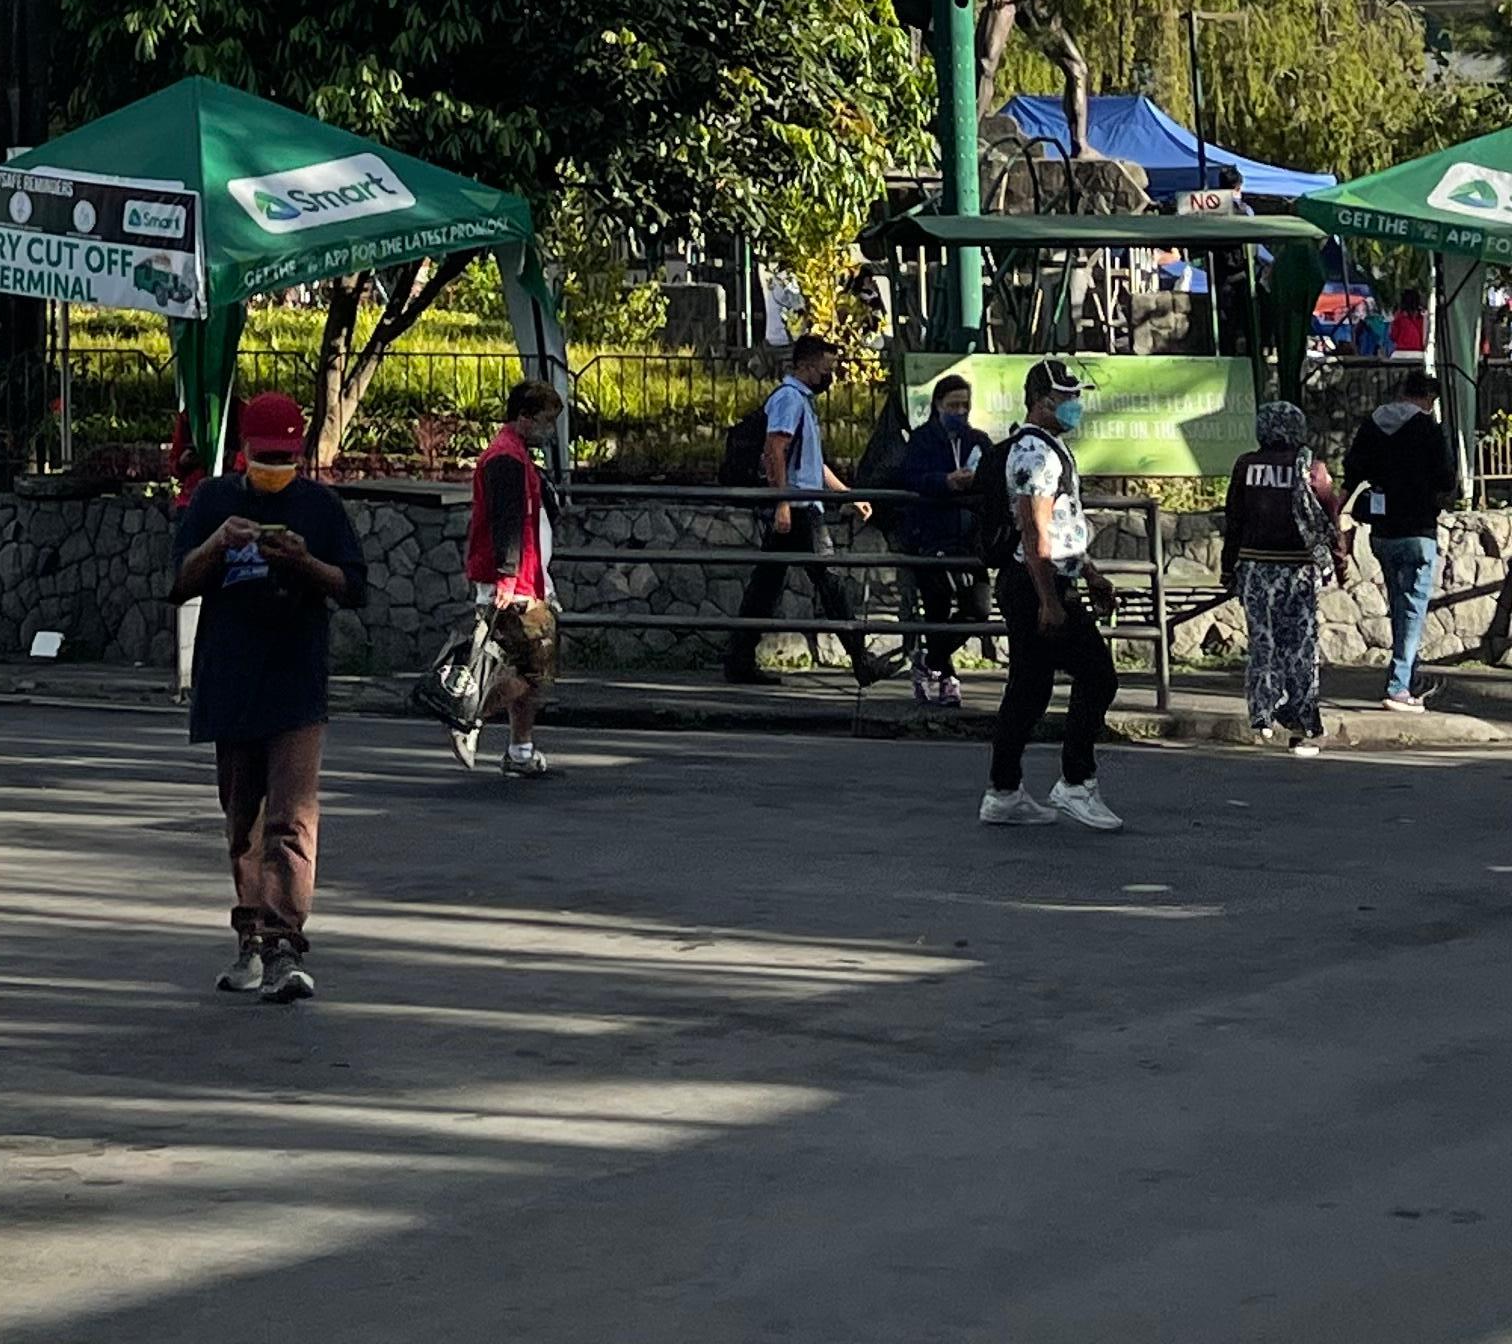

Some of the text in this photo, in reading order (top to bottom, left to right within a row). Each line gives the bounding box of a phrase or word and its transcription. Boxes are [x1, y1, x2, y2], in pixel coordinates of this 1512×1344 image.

[288, 172, 398, 213] Smart
[1190, 193, 1221, 210] NO
[143, 211, 180, 231] Smart
[1337, 209, 1374, 228] GET
[1376, 215, 1409, 236] THE
[1445, 229, 1483, 248] APP
[1486, 236, 1512, 256] FO
[26, 240, 80, 270] CUT
[84, 244, 134, 278] OFF
[244, 266, 270, 289] GET
[270, 259, 297, 281] THE
[325, 249, 350, 269] APP
[351, 241, 378, 265] FOR
[380, 236, 403, 256] THE
[404, 226, 448, 251] LATEST
[1111, 392, 1160, 413] GREEN
[1246, 463, 1293, 488] ITALI
